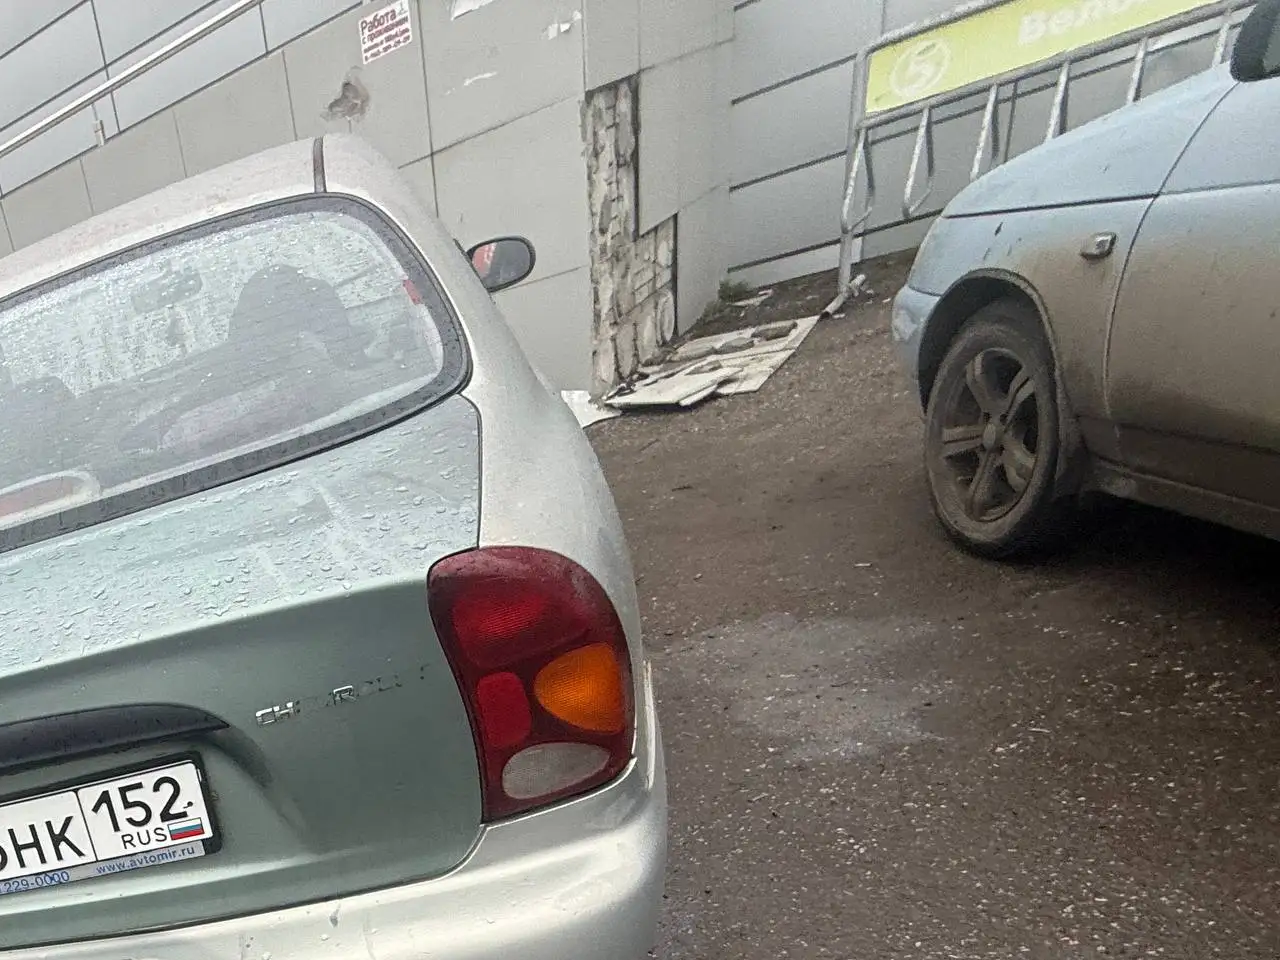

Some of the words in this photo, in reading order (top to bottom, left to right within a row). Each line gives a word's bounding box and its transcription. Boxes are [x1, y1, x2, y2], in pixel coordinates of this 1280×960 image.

[360, 9, 397, 36] Работа
[91, 776, 189, 833] 152
[121, 827, 168, 850] RUS
[96, 846, 196, 874] www.avtomir.ru
